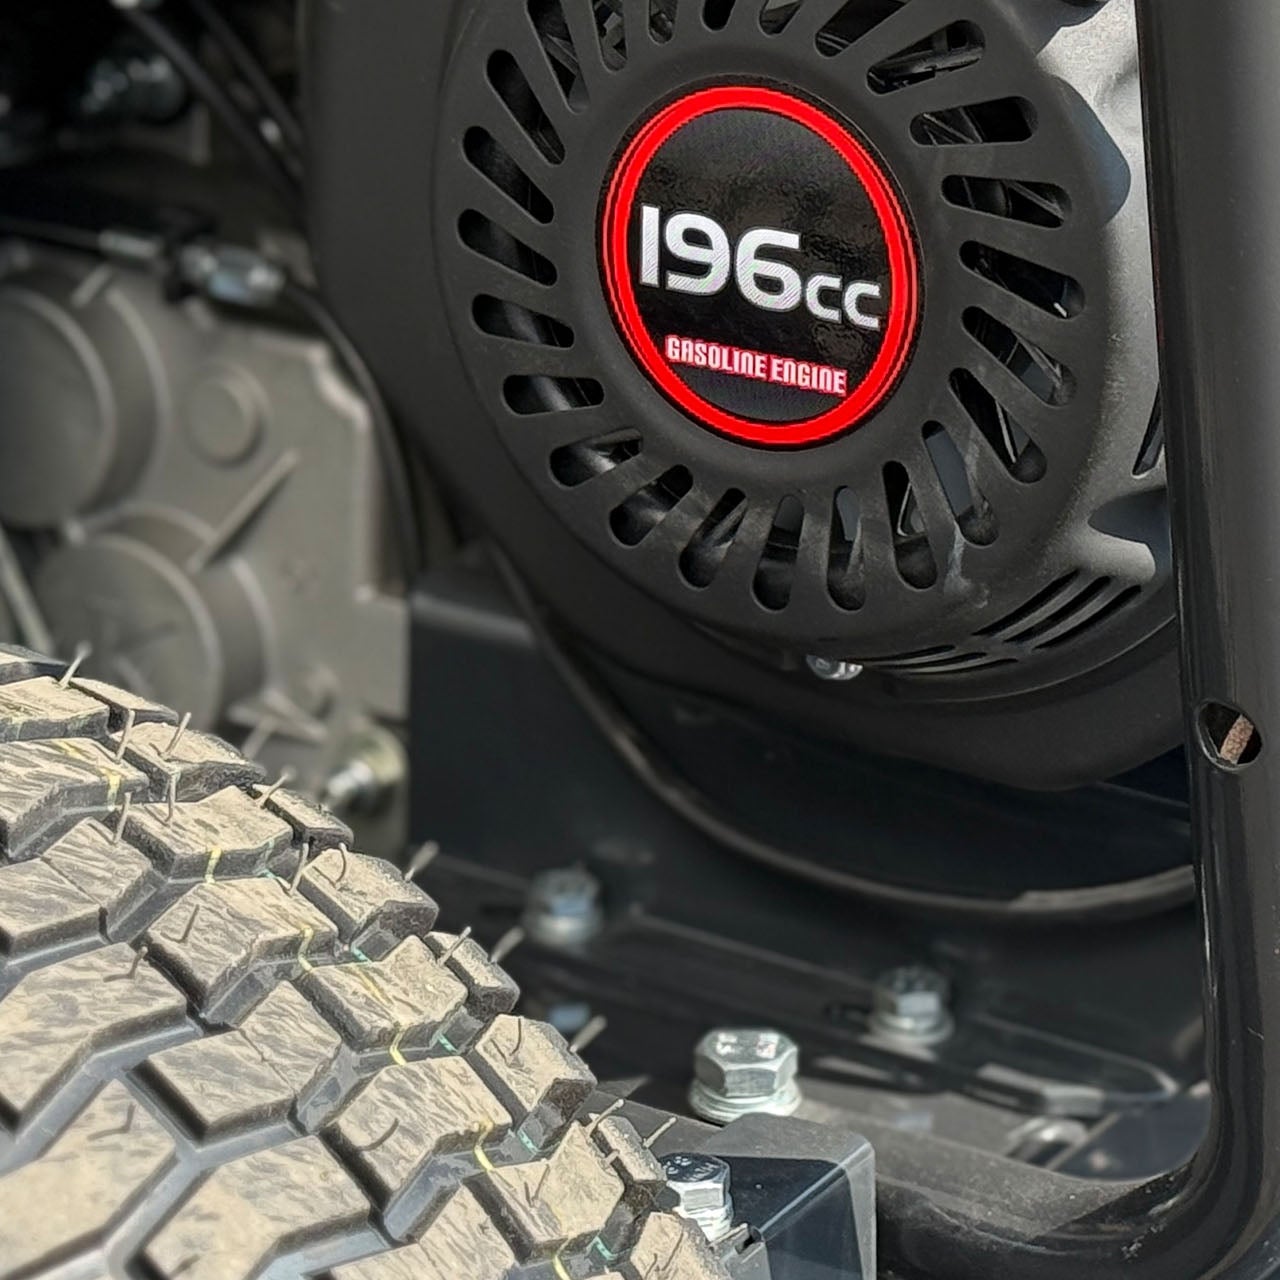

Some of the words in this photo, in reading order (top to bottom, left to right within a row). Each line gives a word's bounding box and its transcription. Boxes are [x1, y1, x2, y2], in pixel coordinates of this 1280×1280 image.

[640, 204, 881, 330] 196cc
[665, 336, 767, 380] GASOLINE
[770, 357, 847, 397] ENGINE
